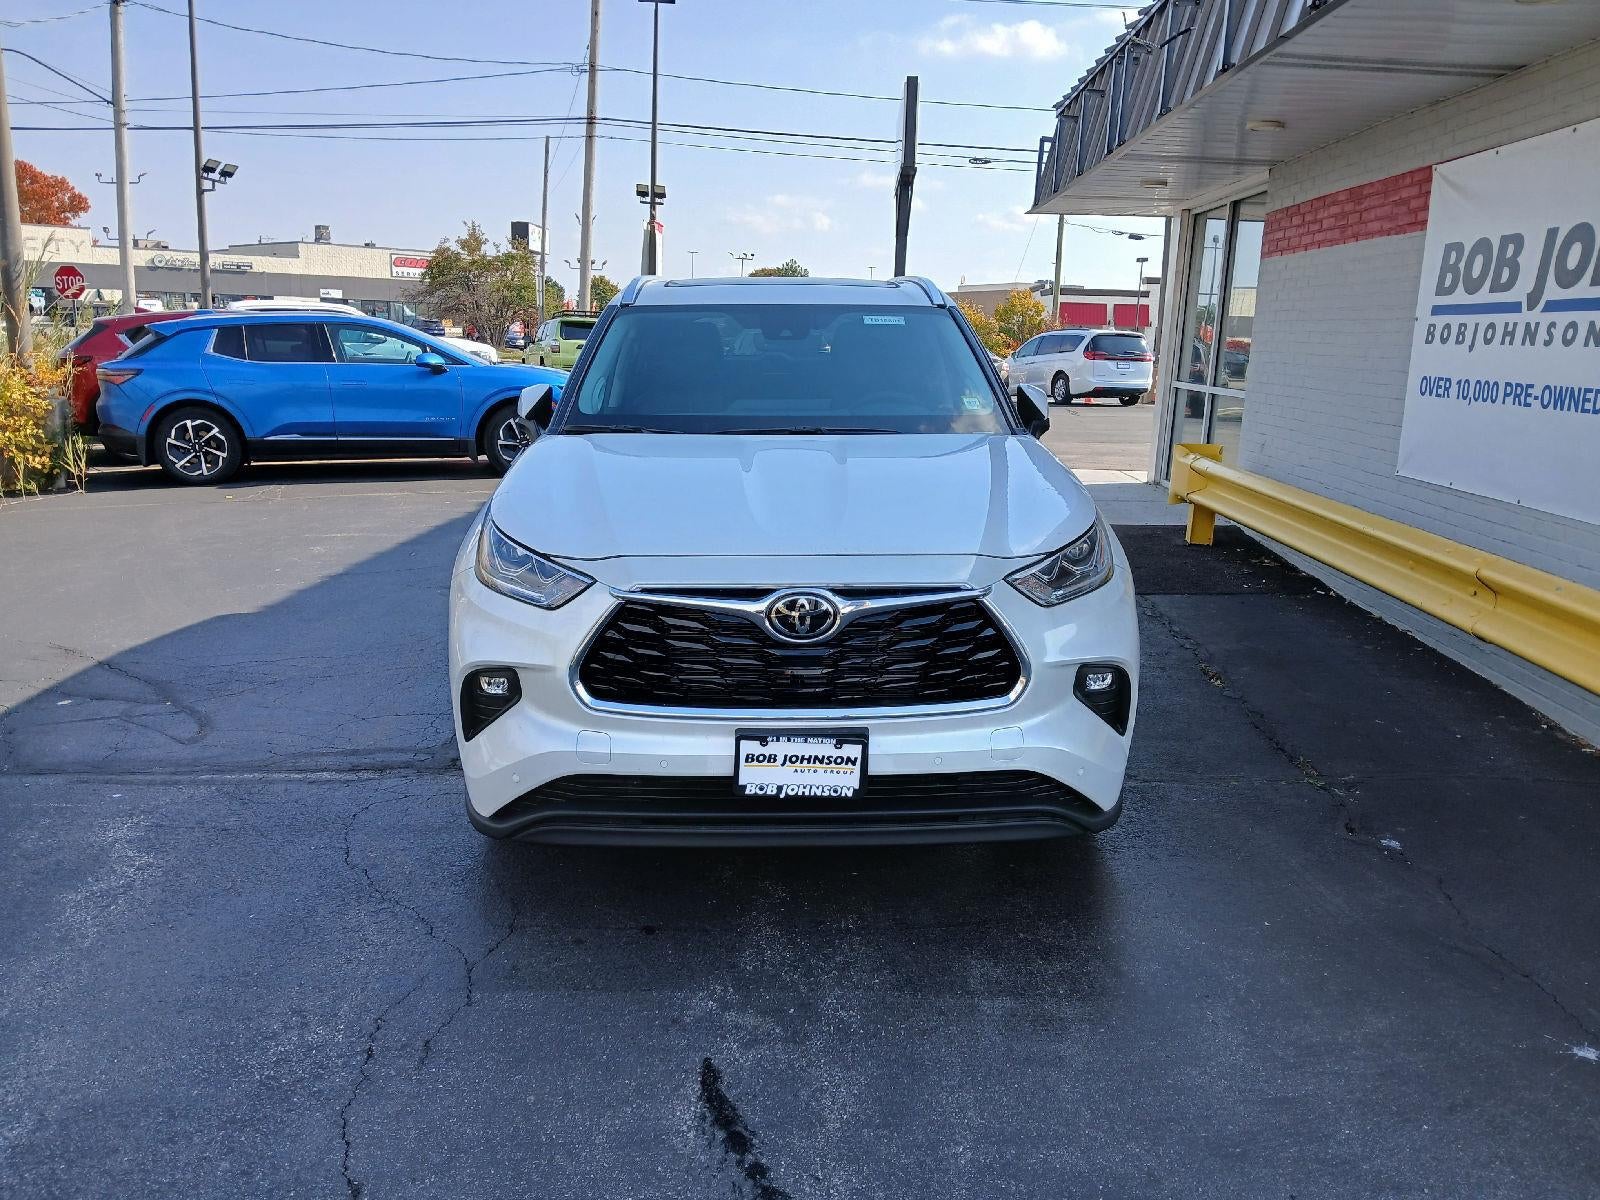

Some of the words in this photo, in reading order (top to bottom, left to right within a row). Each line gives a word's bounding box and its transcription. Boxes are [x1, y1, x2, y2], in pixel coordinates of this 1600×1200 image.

[1435, 233, 1525, 296] BOB
[56, 275, 83, 289] STOP
[1419, 375, 1452, 399] OVER
[1455, 378, 1500, 406] 10,000
[1502, 381, 1600, 415] PRE-OWNED
[745, 753, 778, 764] BOB
[780, 753, 859, 767] JOHNSON
[745, 783, 778, 795] BOB
[779, 784, 854, 798] JOHNSON
